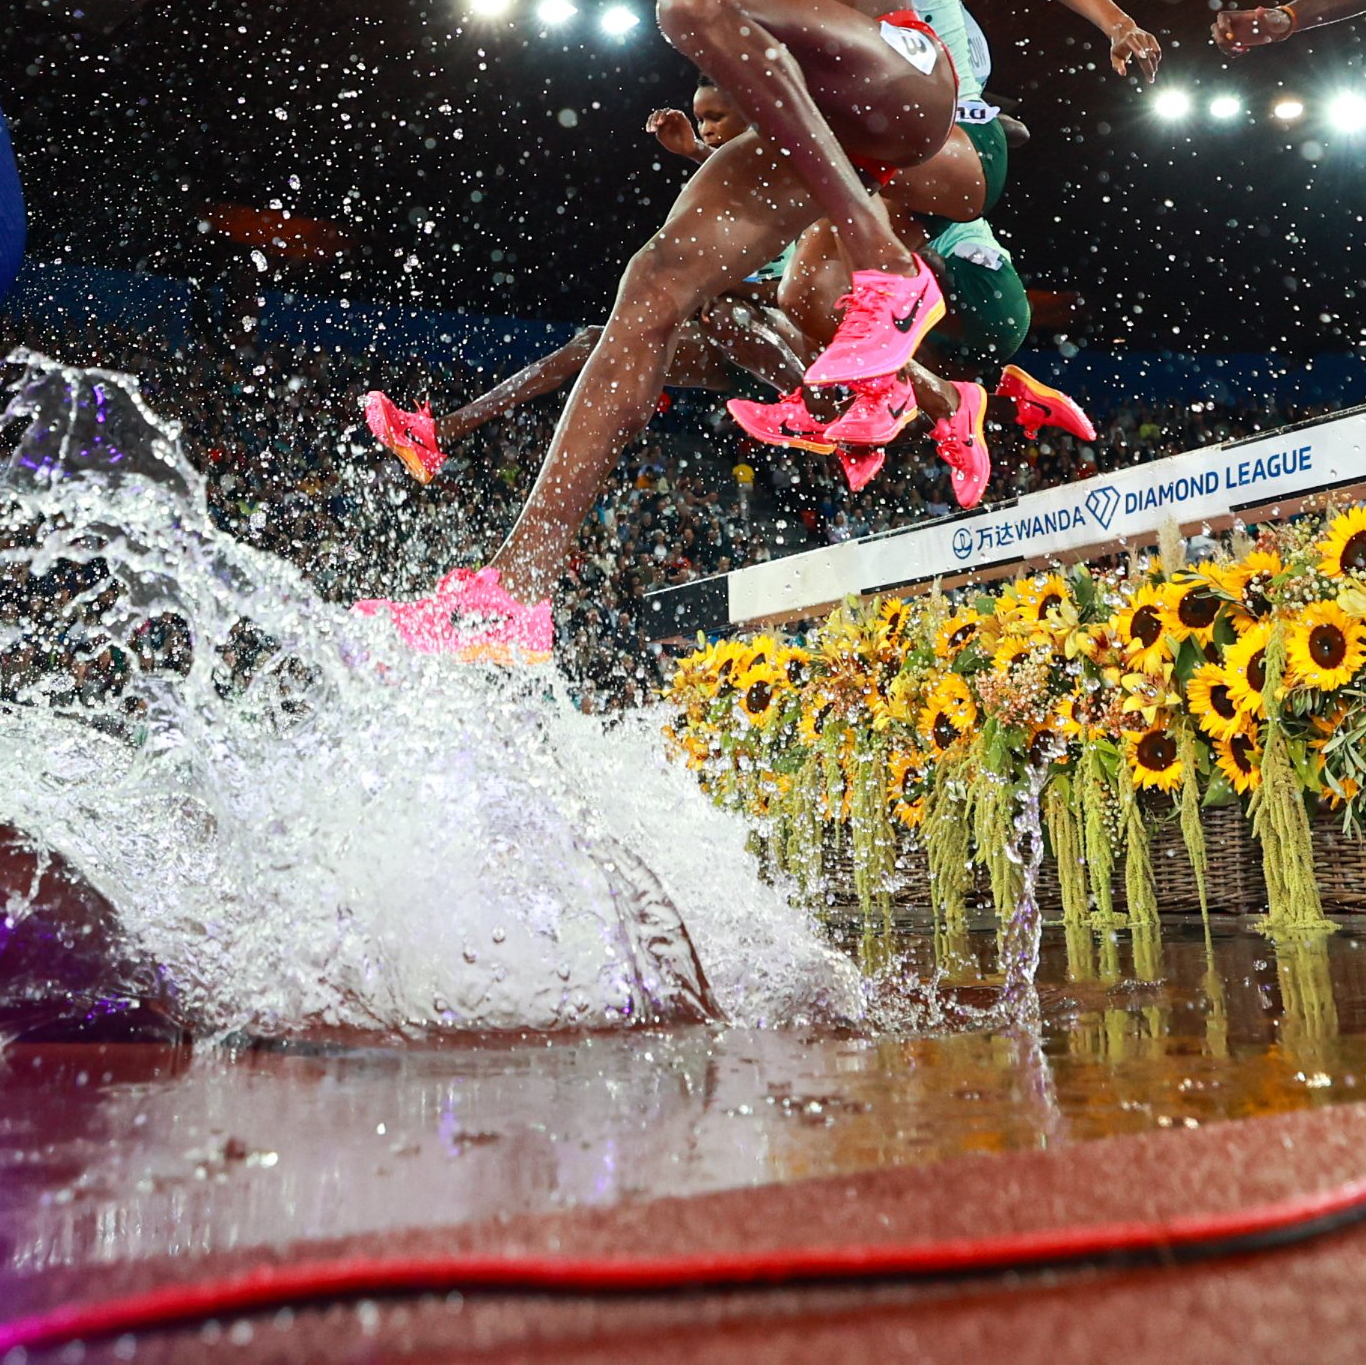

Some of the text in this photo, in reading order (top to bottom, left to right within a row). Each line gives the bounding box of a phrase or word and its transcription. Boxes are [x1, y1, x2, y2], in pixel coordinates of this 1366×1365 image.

[1015, 506, 1086, 541] WANDA
[1125, 471, 1219, 515] DIAMOND
[1226, 446, 1312, 489] LEAGUE
